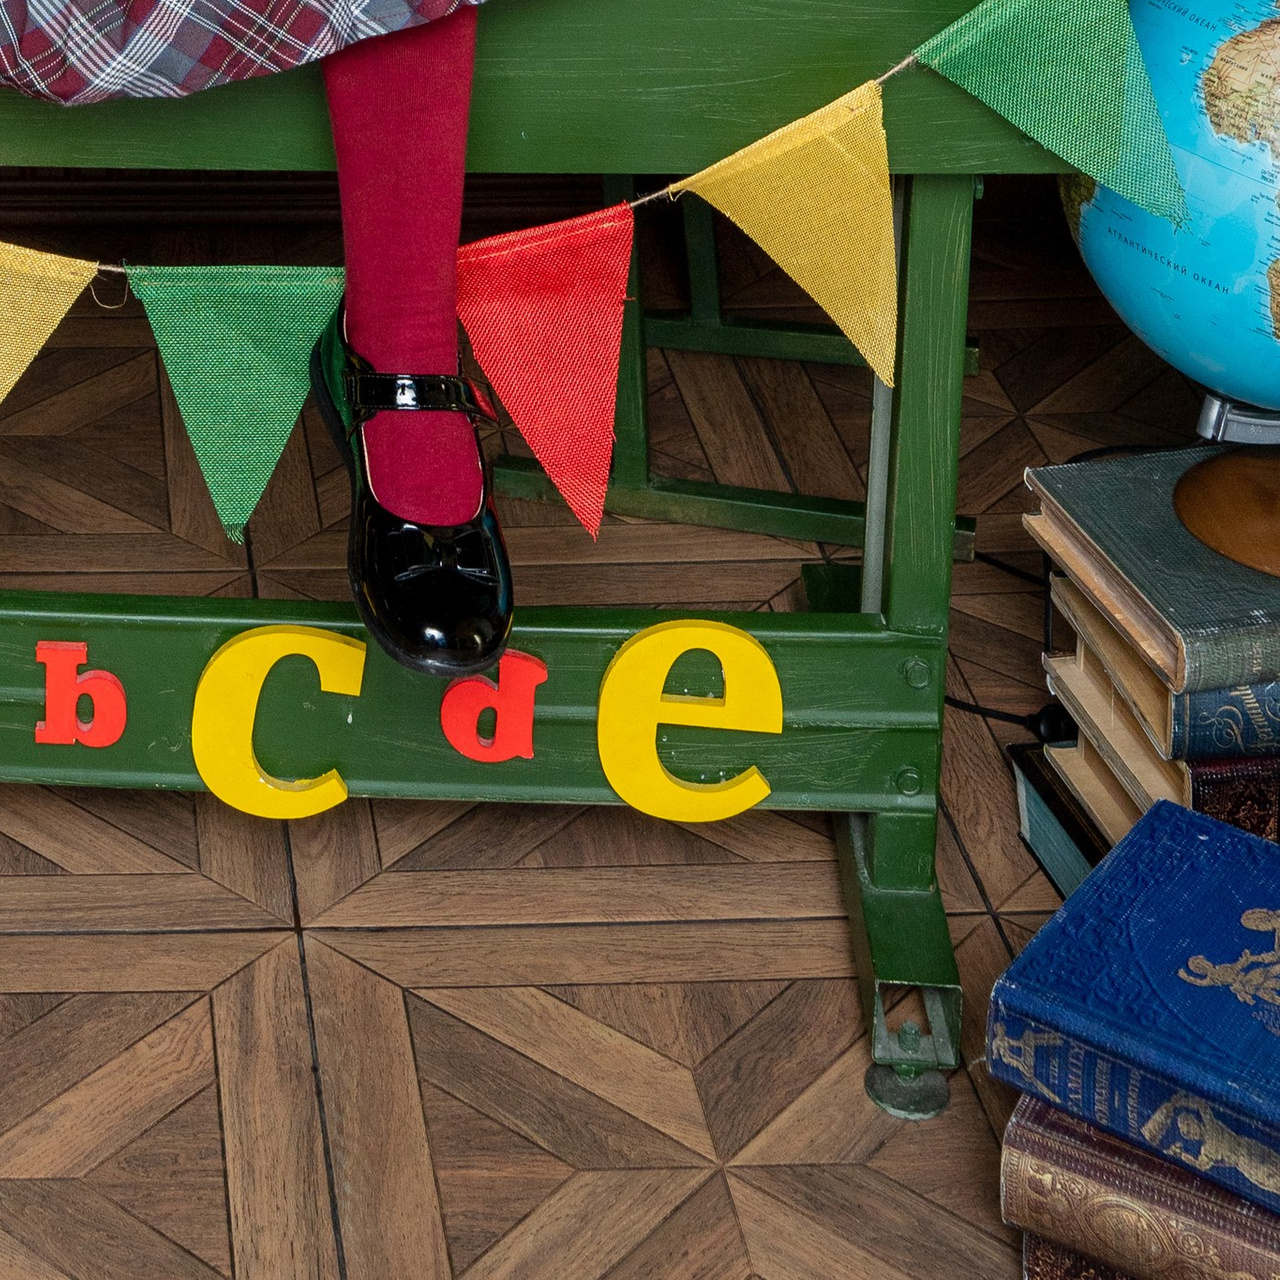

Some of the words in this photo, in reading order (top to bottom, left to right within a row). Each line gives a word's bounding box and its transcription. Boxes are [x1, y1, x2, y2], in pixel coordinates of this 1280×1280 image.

[1188, 13, 1218, 32] ОКЕАН
[1107, 226, 1187, 276] АТЛАНТИЧЕСКИЙ
[1192, 272, 1231, 295] ОКЕАН
[33, 640, 128, 748] b
[190, 624, 367, 820] c
[439, 647, 550, 764] d
[596, 619, 785, 824] e
